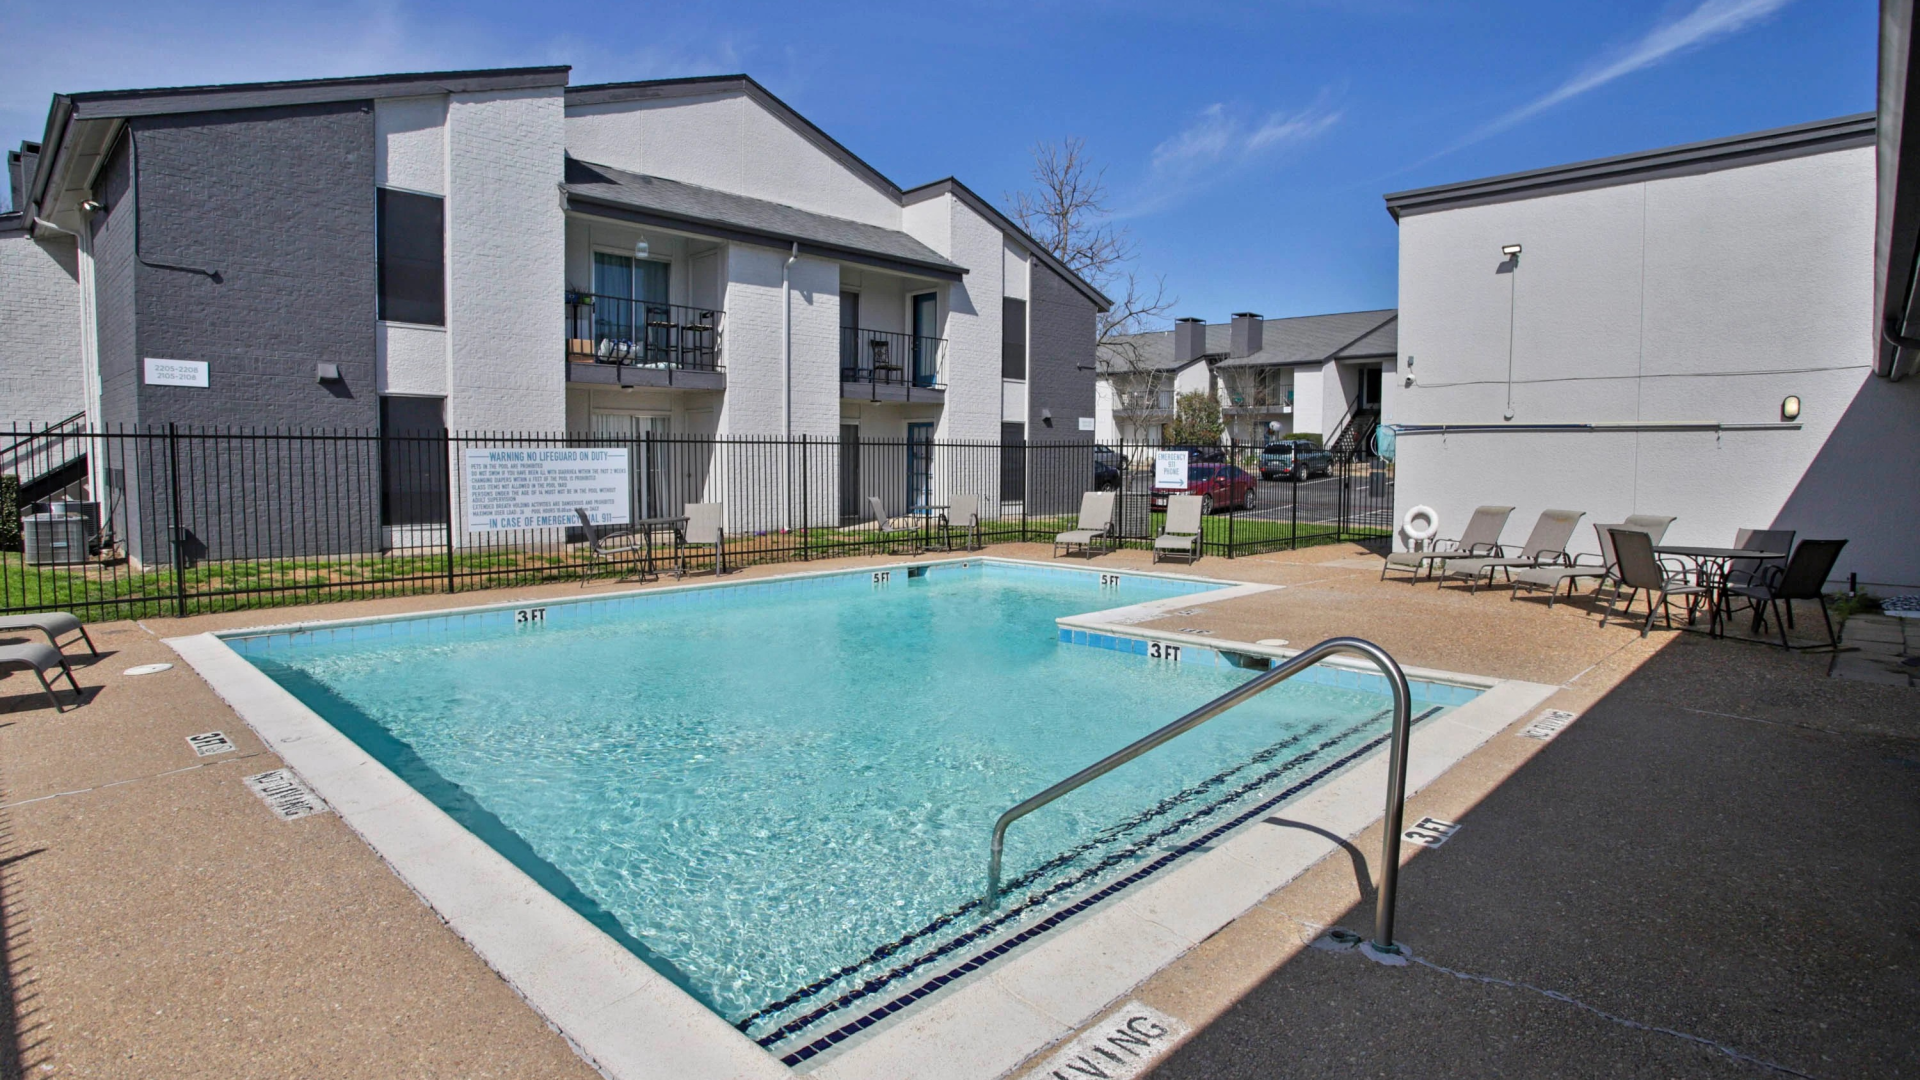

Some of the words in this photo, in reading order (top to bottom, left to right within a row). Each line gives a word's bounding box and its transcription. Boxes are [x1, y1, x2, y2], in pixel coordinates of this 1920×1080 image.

[155, 365, 198, 373] 2205-2208
[490, 452, 525, 462] WARNING
[526, 452, 538, 461] NO
[539, 451, 578, 461] LIFEGUARD
[579, 451, 590, 460] ON
[590, 451, 608, 460] DUTY
[1158, 453, 1186, 461] EMERGENCY
[490, 518, 498, 529] IN
[500, 517, 521, 528] CASE
[524, 516, 534, 527] OF
[601, 512, 612, 523] 911
[874, 573, 879, 583] 5
[881, 572, 890, 582] FT
[1101, 575, 1108, 585] 5
[1110, 576, 1119, 586] FT
[518, 610, 528, 622] 3
[532, 608, 545, 621] FT
[1151, 643, 1161, 659] 3
[1165, 645, 1181, 661] FT
